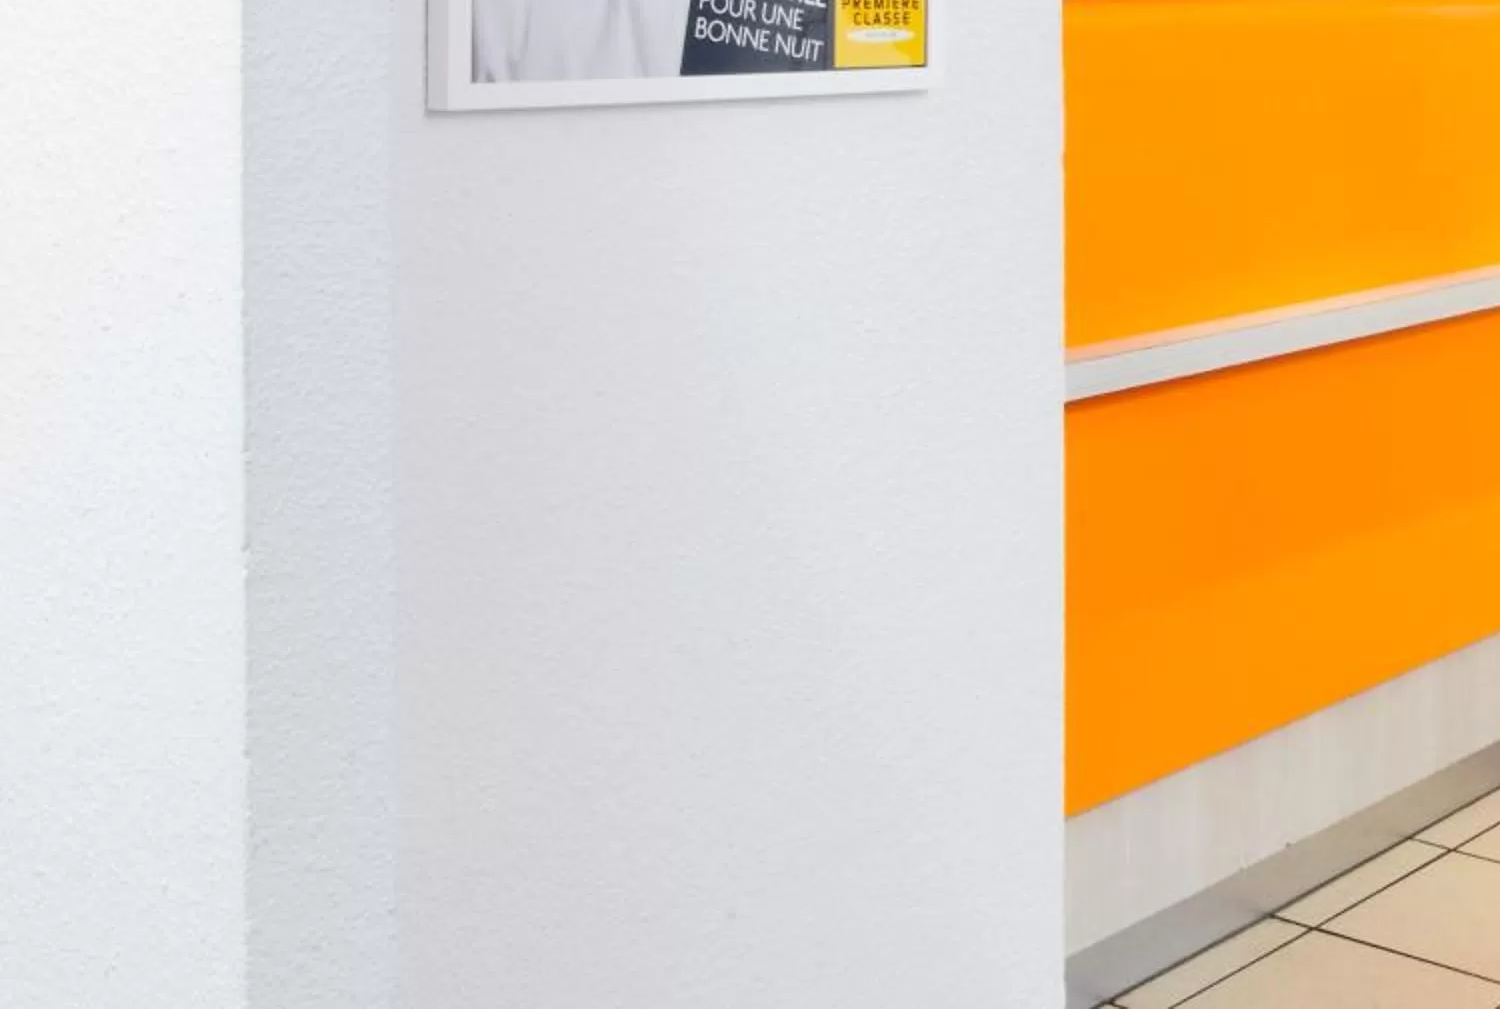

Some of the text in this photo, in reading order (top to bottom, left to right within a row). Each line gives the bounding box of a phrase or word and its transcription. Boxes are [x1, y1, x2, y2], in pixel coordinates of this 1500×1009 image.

[761, 6, 803, 31] UNE
[853, 11, 912, 26] CLASSE
[695, 16, 824, 62] BONNE NUIT
